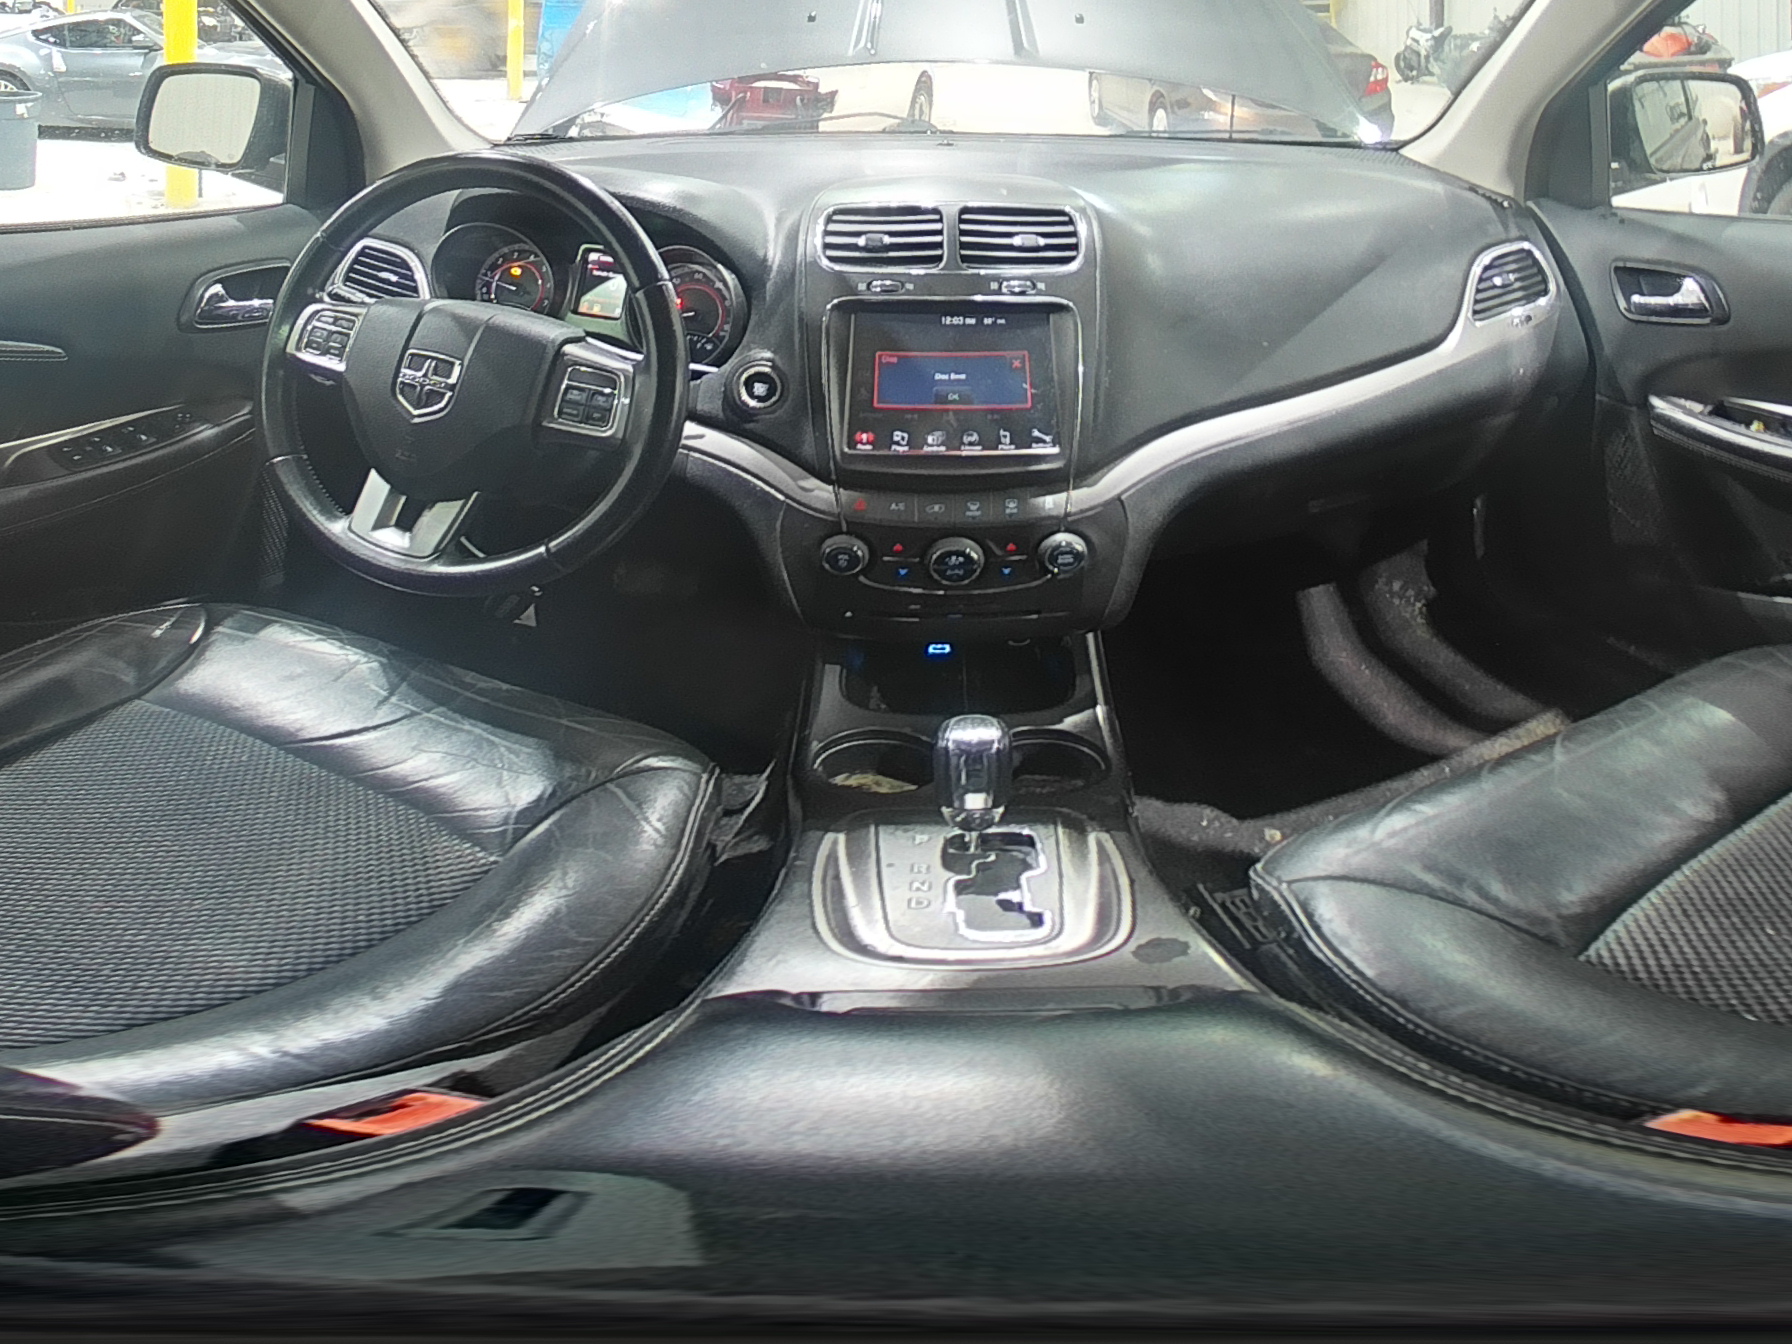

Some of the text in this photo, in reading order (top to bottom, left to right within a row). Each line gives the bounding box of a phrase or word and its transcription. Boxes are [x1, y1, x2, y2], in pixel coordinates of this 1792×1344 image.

[941, 315, 964, 325] 12:03
[913, 834, 929, 845] P
[910, 880, 932, 892] N
[908, 897, 930, 909] D
